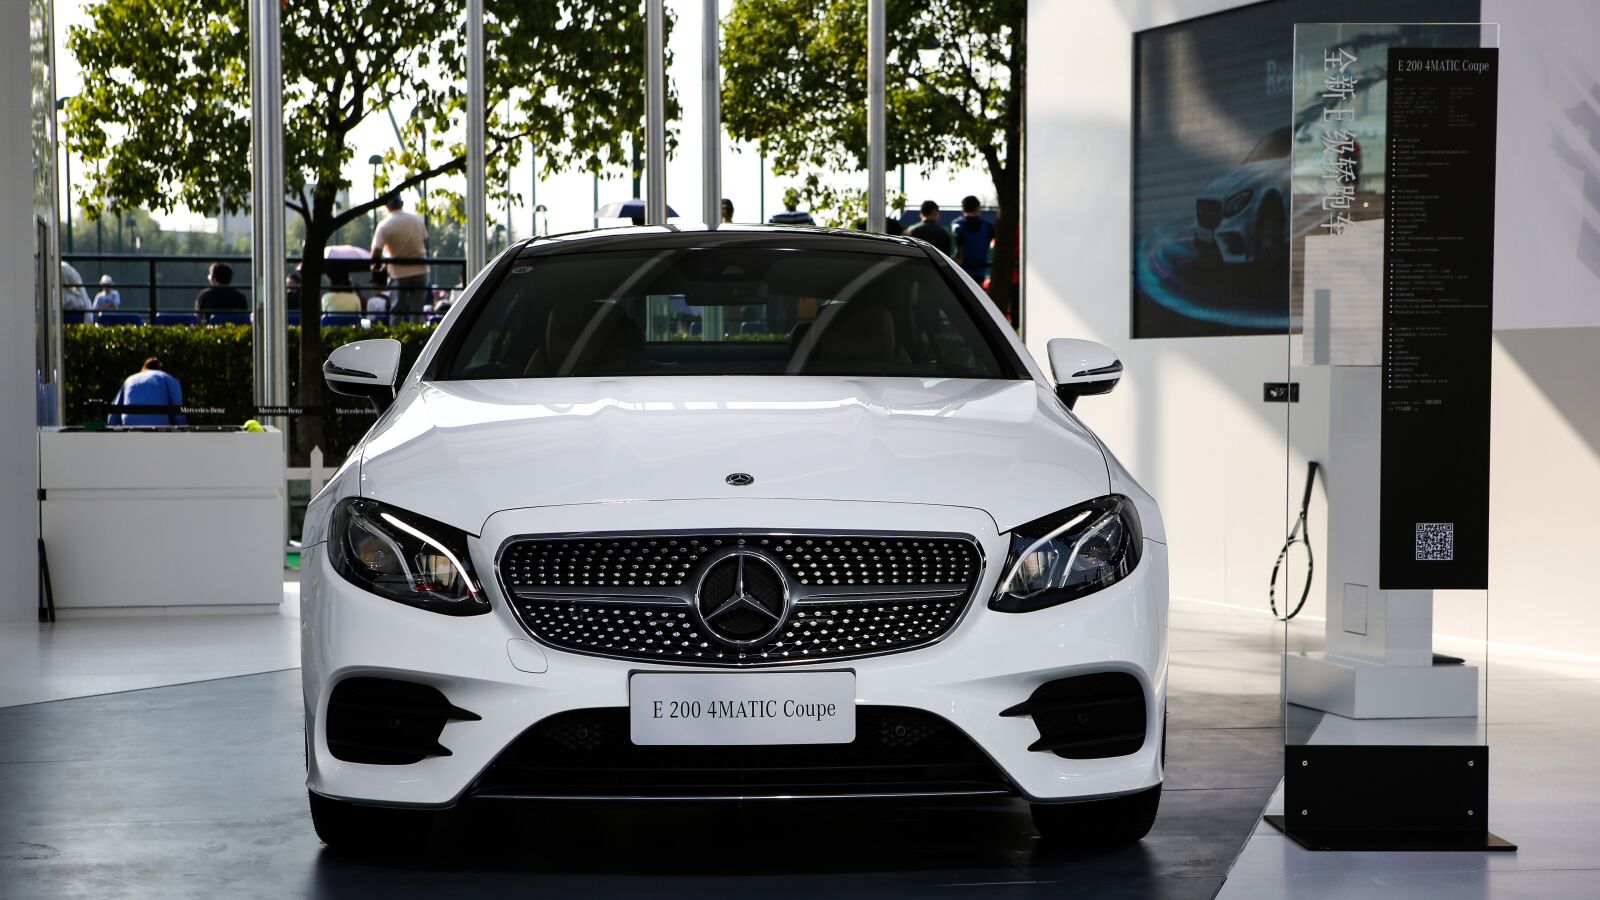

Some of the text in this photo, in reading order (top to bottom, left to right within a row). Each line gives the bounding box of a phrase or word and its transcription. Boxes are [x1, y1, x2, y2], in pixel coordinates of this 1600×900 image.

[1398, 60, 1490, 74] E 200 4MATIC Coupe
[258, 407, 303, 415] Mercedes-Benz
[335, 407, 378, 415] Mercedes-Ben
[652, 699, 837, 722] E 200 4MATIC Coupe
